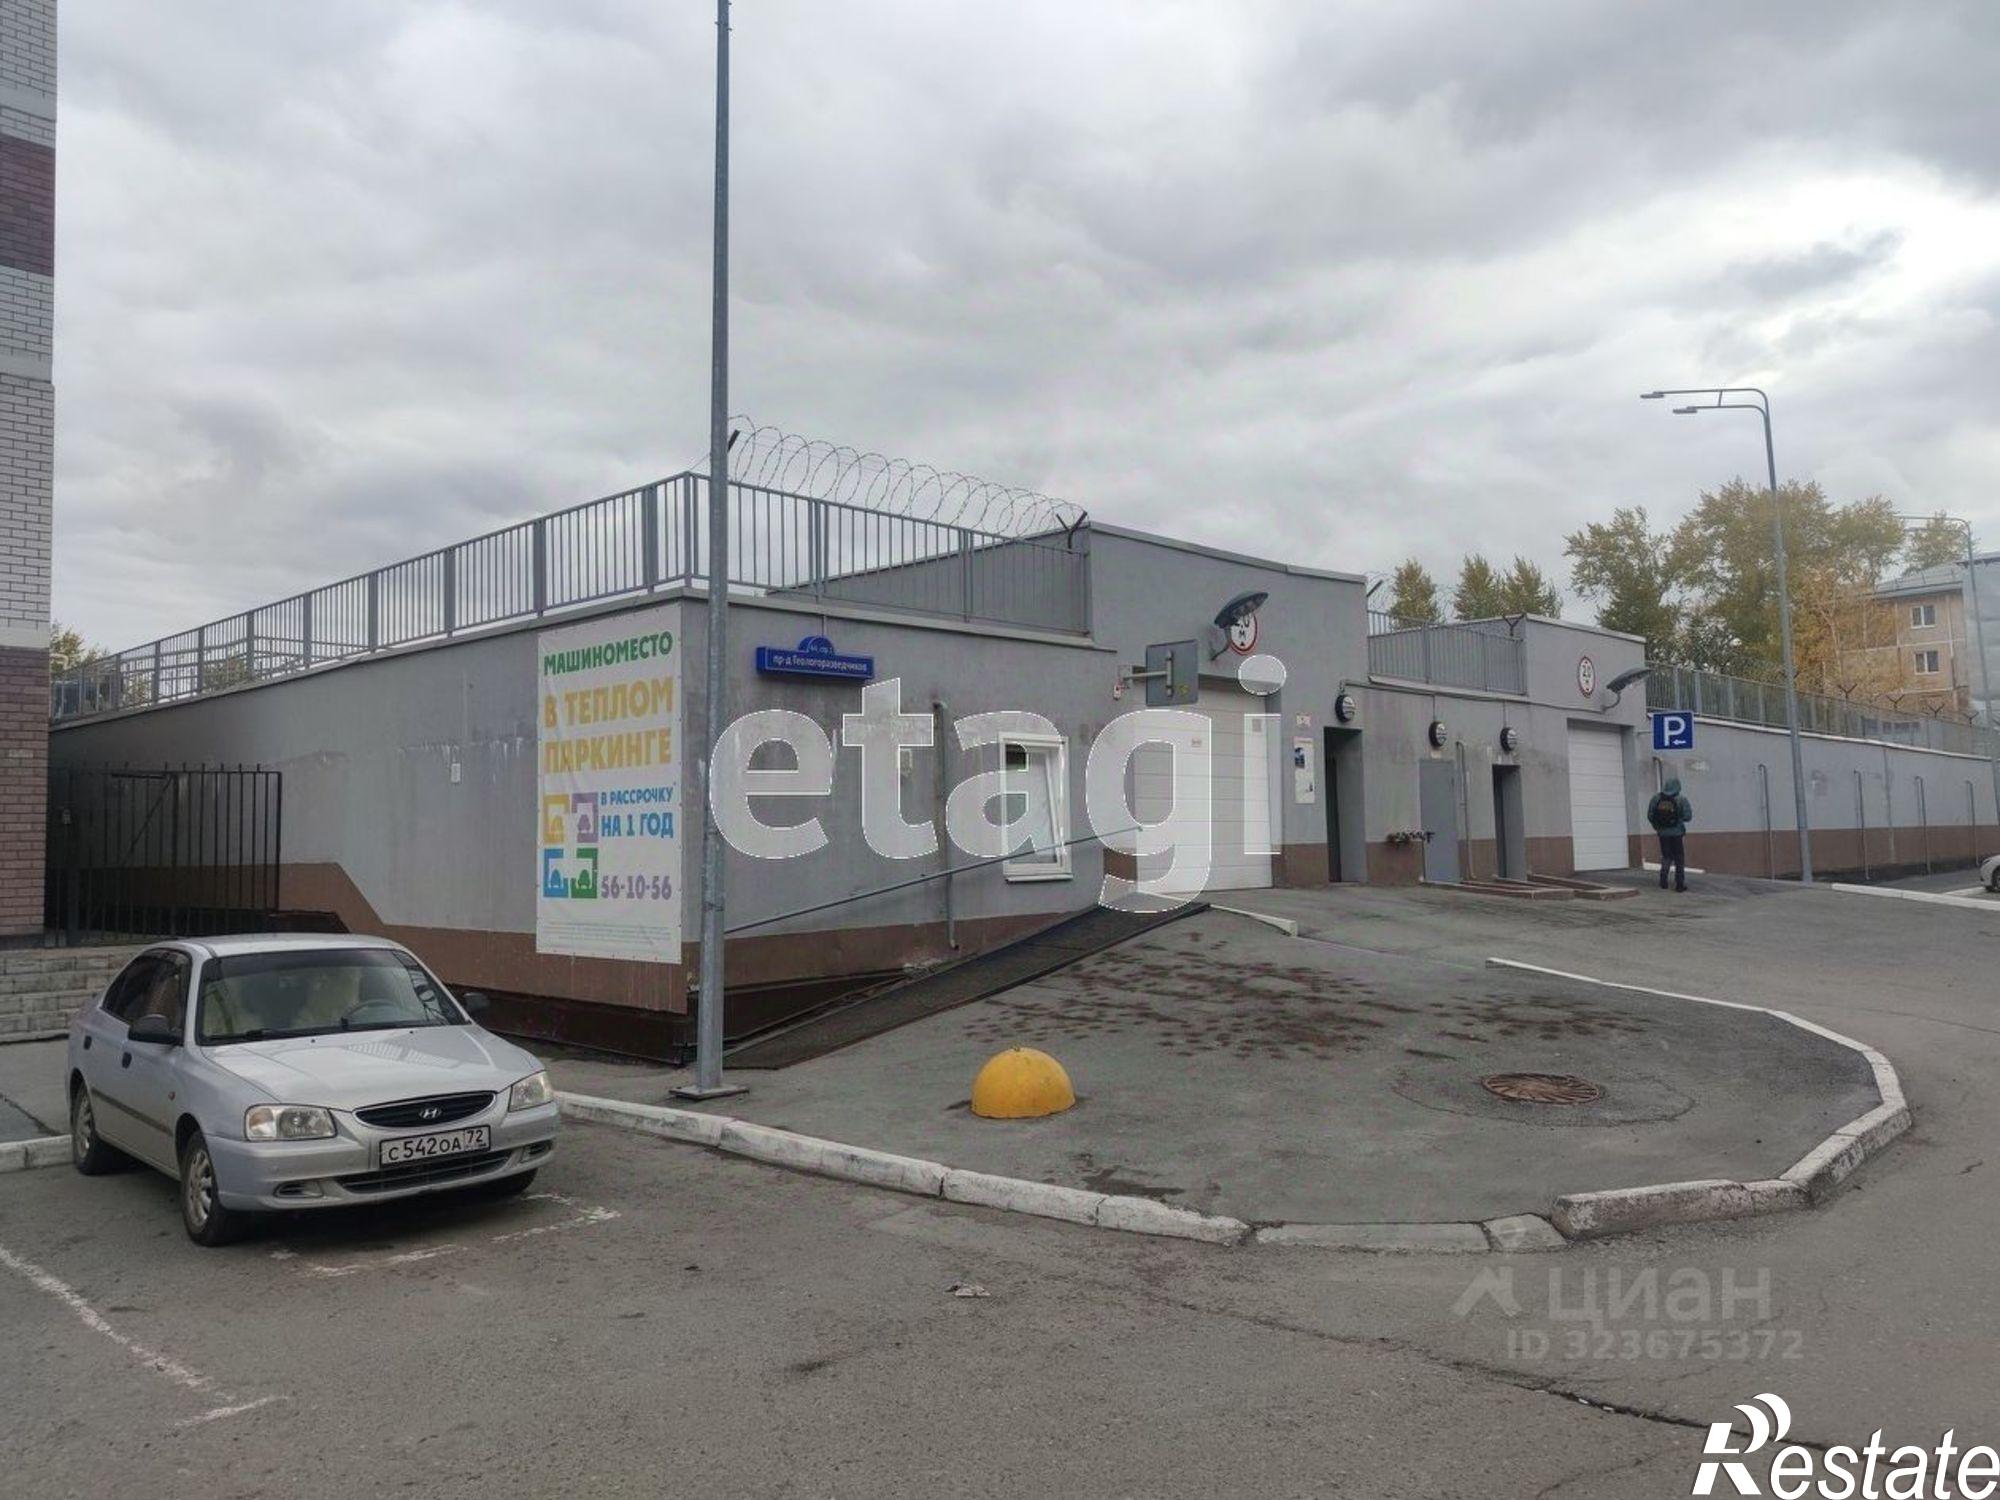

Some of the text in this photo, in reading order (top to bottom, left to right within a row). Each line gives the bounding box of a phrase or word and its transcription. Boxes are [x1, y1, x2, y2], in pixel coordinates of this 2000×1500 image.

[543, 631, 673, 676] МАШИНОМЕСТО
[545, 676, 674, 729] В ТЕПЛОМ
[1664, 716, 1686, 747] P
[546, 727, 673, 774] ПАРКИНГЕ
[600, 786, 674, 806] В РАССРОЧКУ
[601, 811, 674, 839] НА 1 ГОД
[601, 875, 673, 900] 56-10-56
